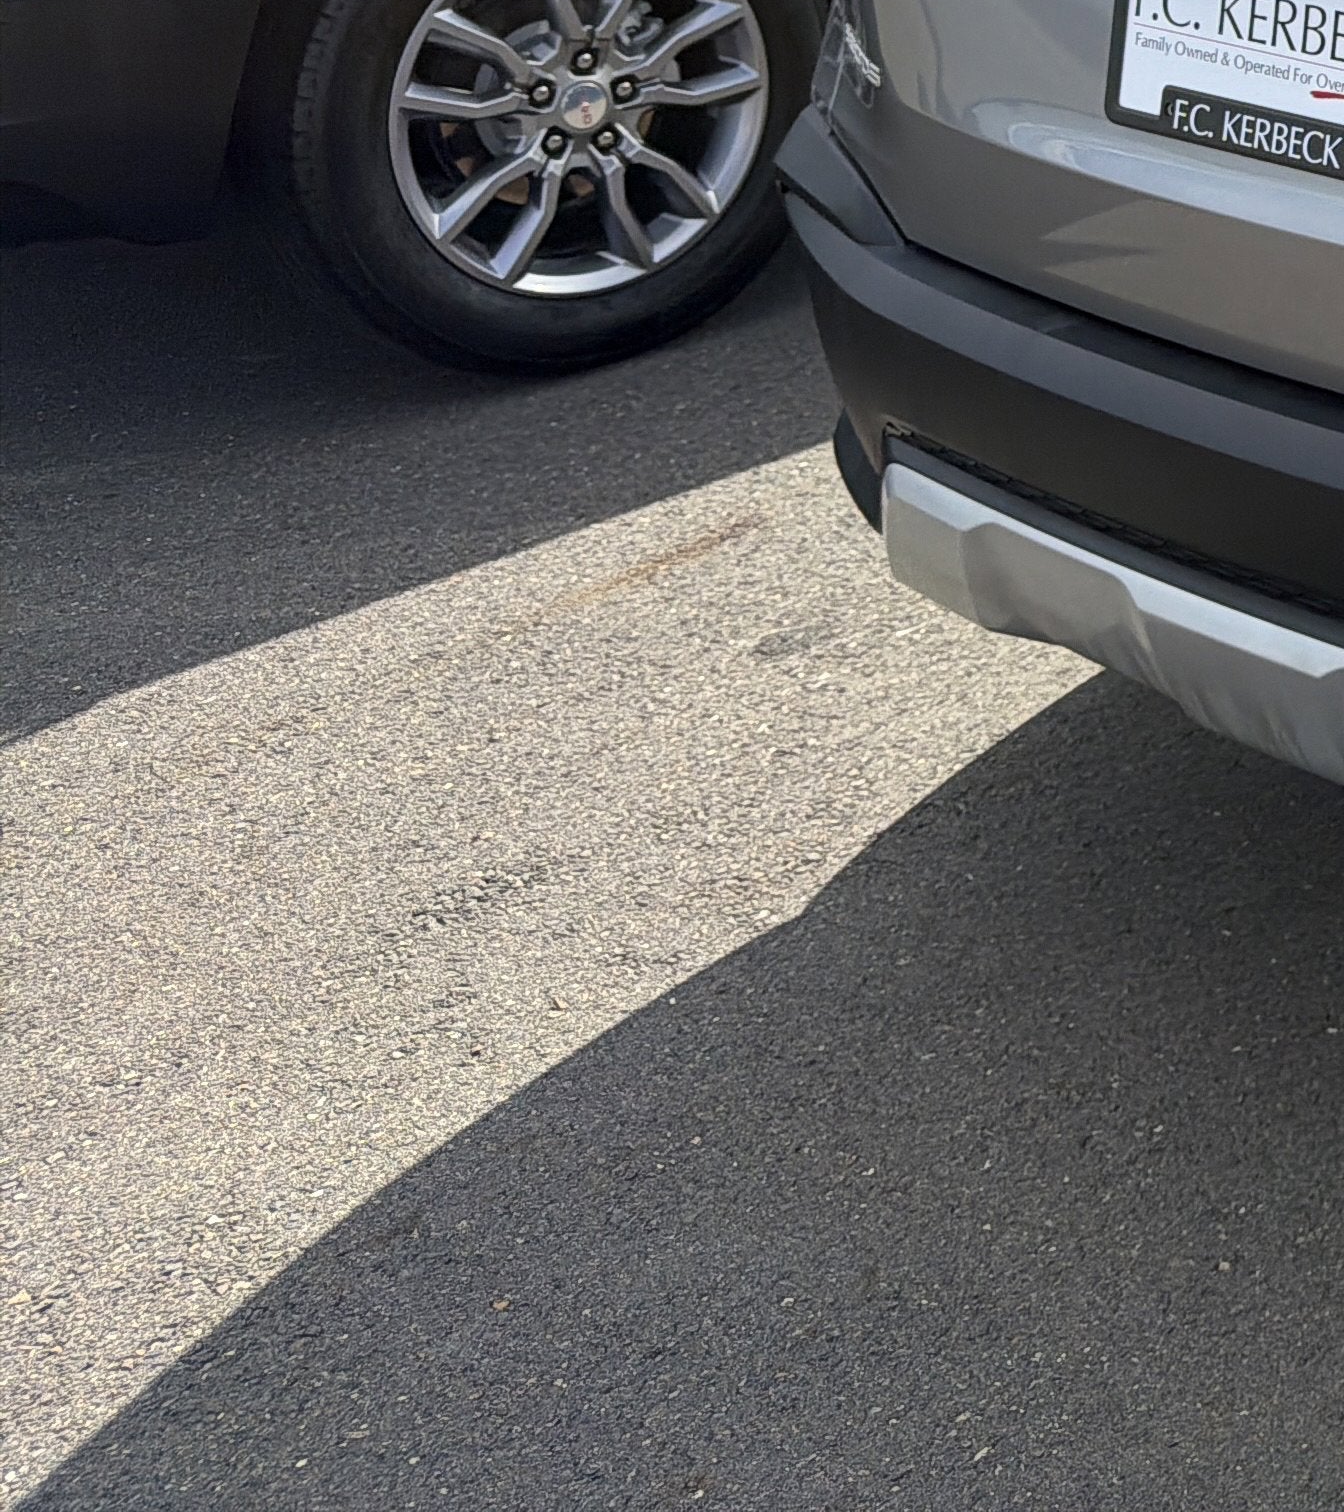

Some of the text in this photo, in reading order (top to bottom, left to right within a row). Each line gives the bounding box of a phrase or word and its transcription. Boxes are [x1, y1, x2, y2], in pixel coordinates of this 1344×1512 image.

[1134, 33, 1171, 56] Family
[1174, 41, 1218, 65] Owned
[1220, 52, 1231, 66] &
[1234, 54, 1290, 81] Operated
[1293, 68, 1313, 85] For
[1173, 98, 1343, 169] F.C. KERBECK
